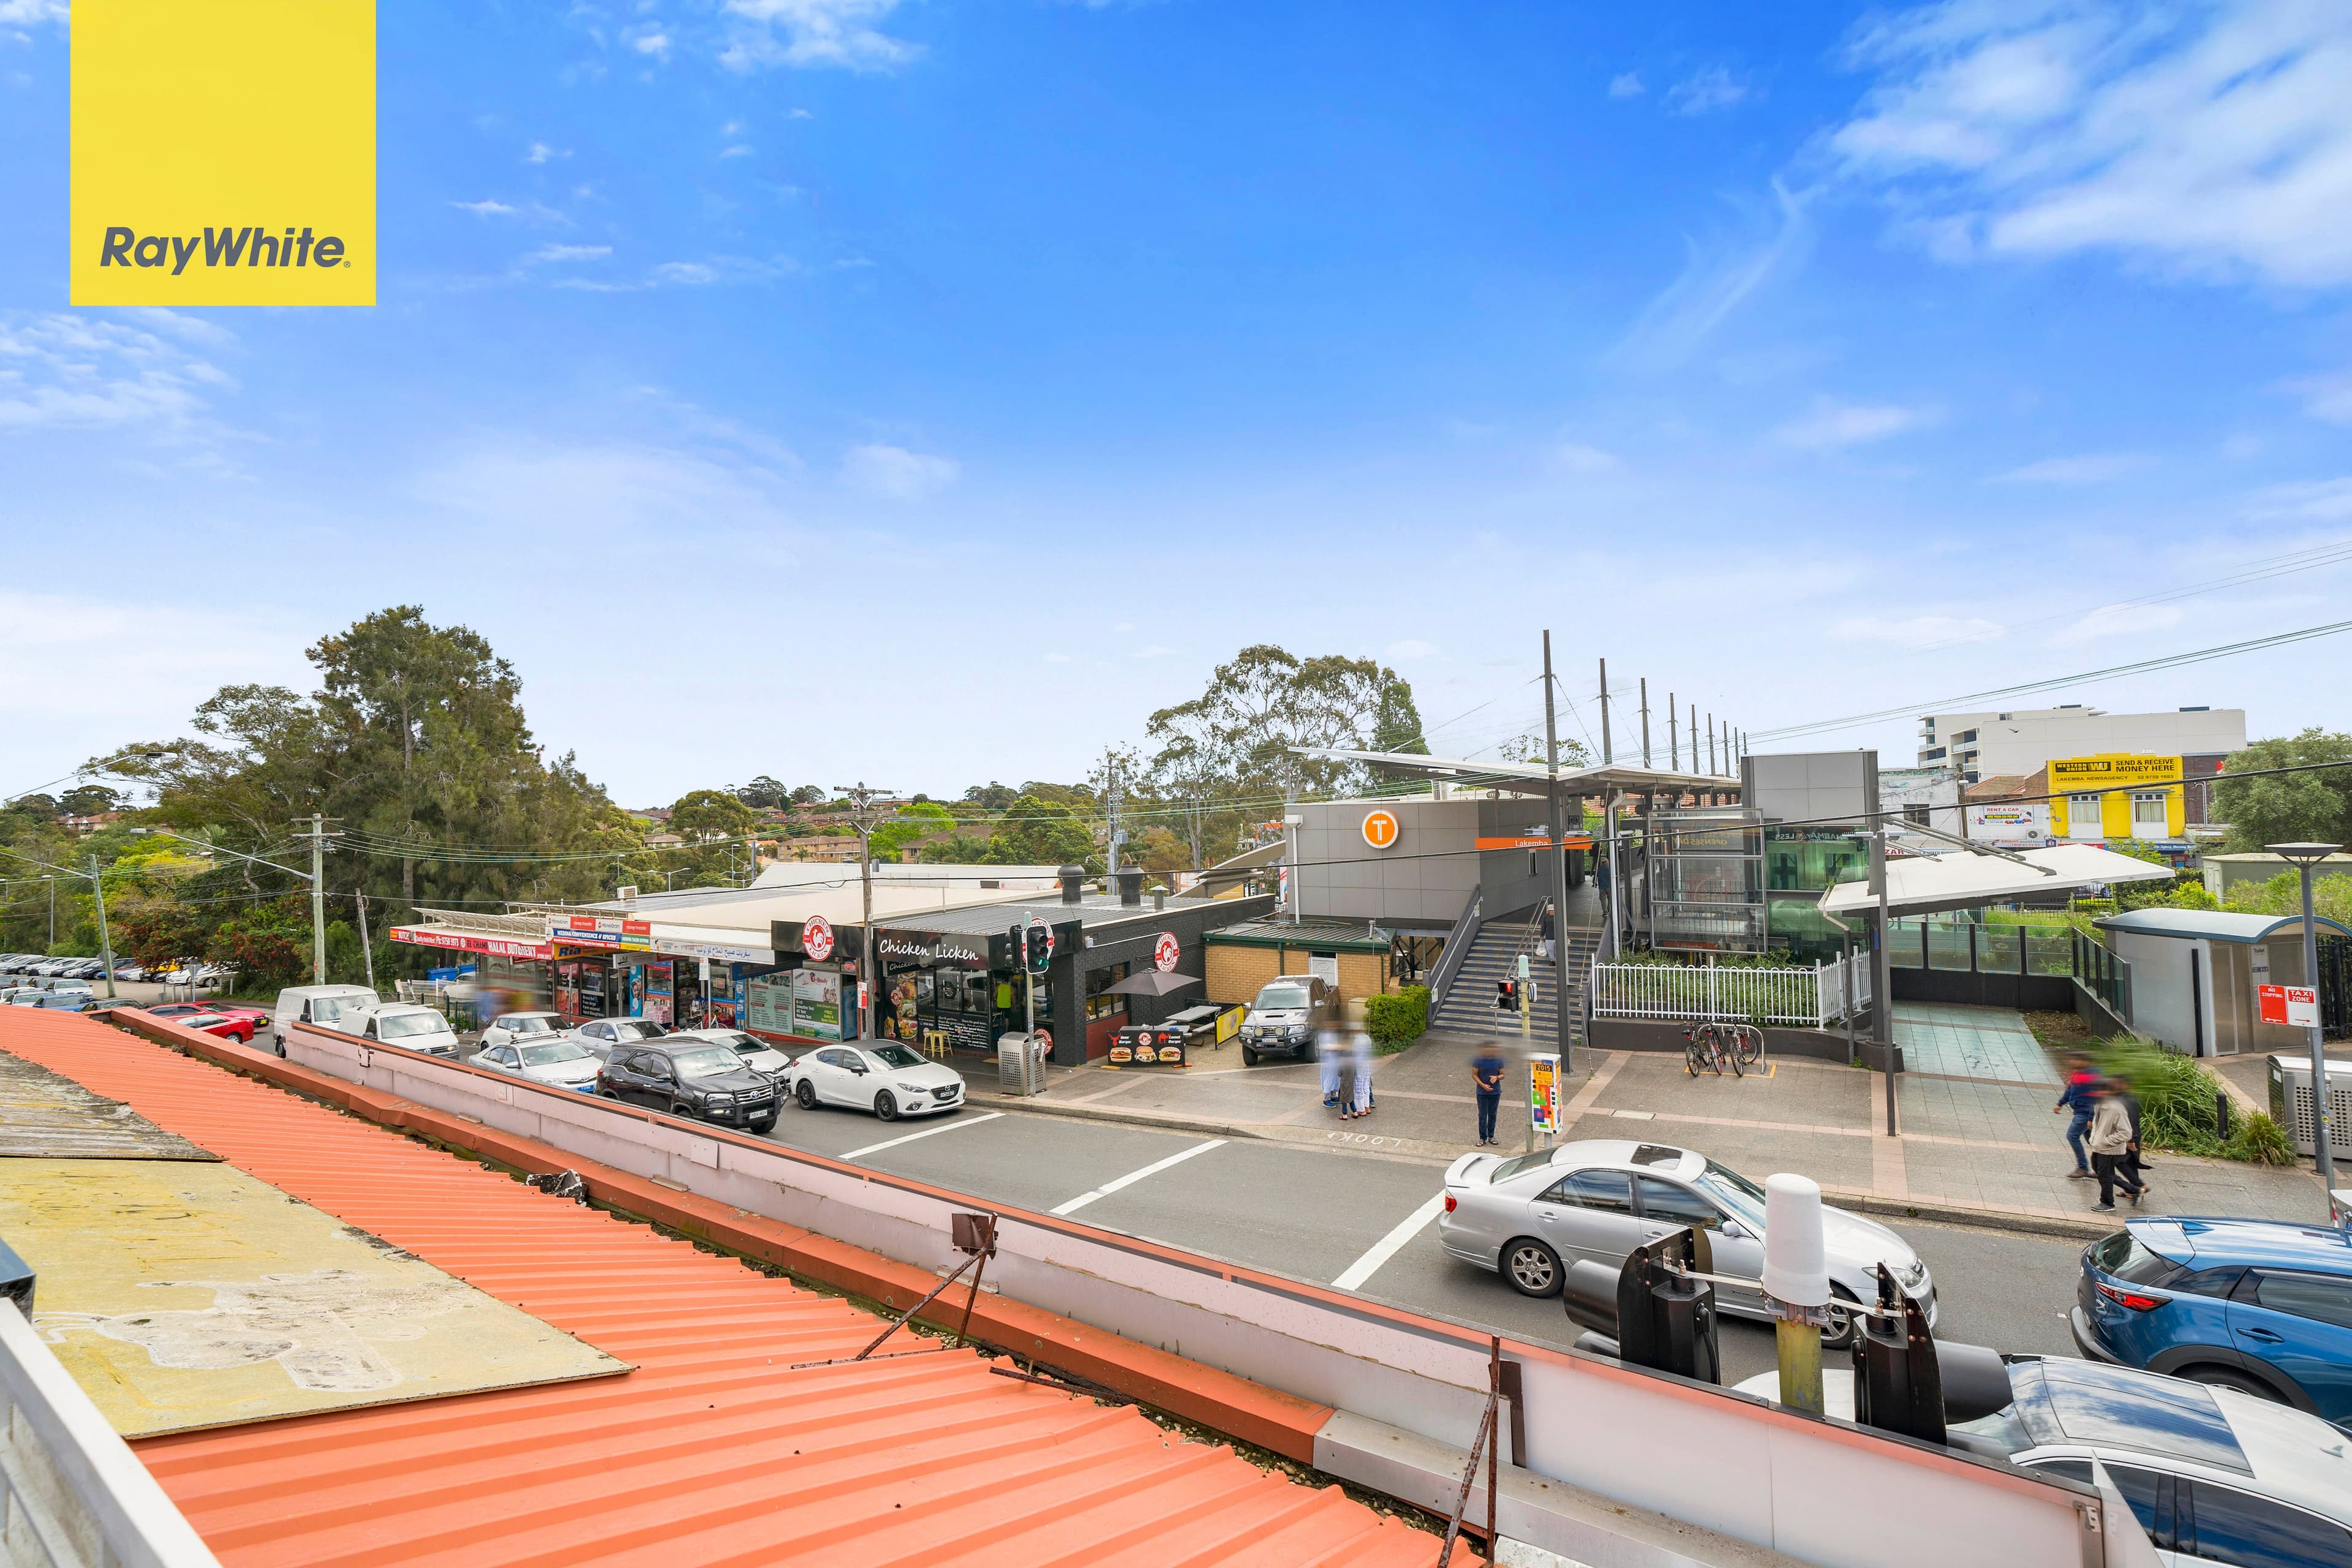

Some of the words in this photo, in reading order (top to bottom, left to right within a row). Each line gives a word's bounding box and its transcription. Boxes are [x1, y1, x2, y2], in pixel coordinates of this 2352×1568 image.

[2090, 762, 2108, 771] WU
[1372, 820, 1387, 841] T
[807, 919, 830, 933] CHICKEN
[572, 930, 598, 939] CONVENIENCE
[1158, 935, 1176, 949] CHICKEN
[488, 941, 507, 954] HALAL
[507, 943, 536, 957] BUTCHERY
[559, 945, 581, 957] Ria
[809, 948, 828, 959] LICKEN
[880, 938, 930, 956] Chicken
[935, 943, 979, 961] Licken
[889, 962, 916, 971] Chicken
[1160, 960, 1175, 971] LICKEN
